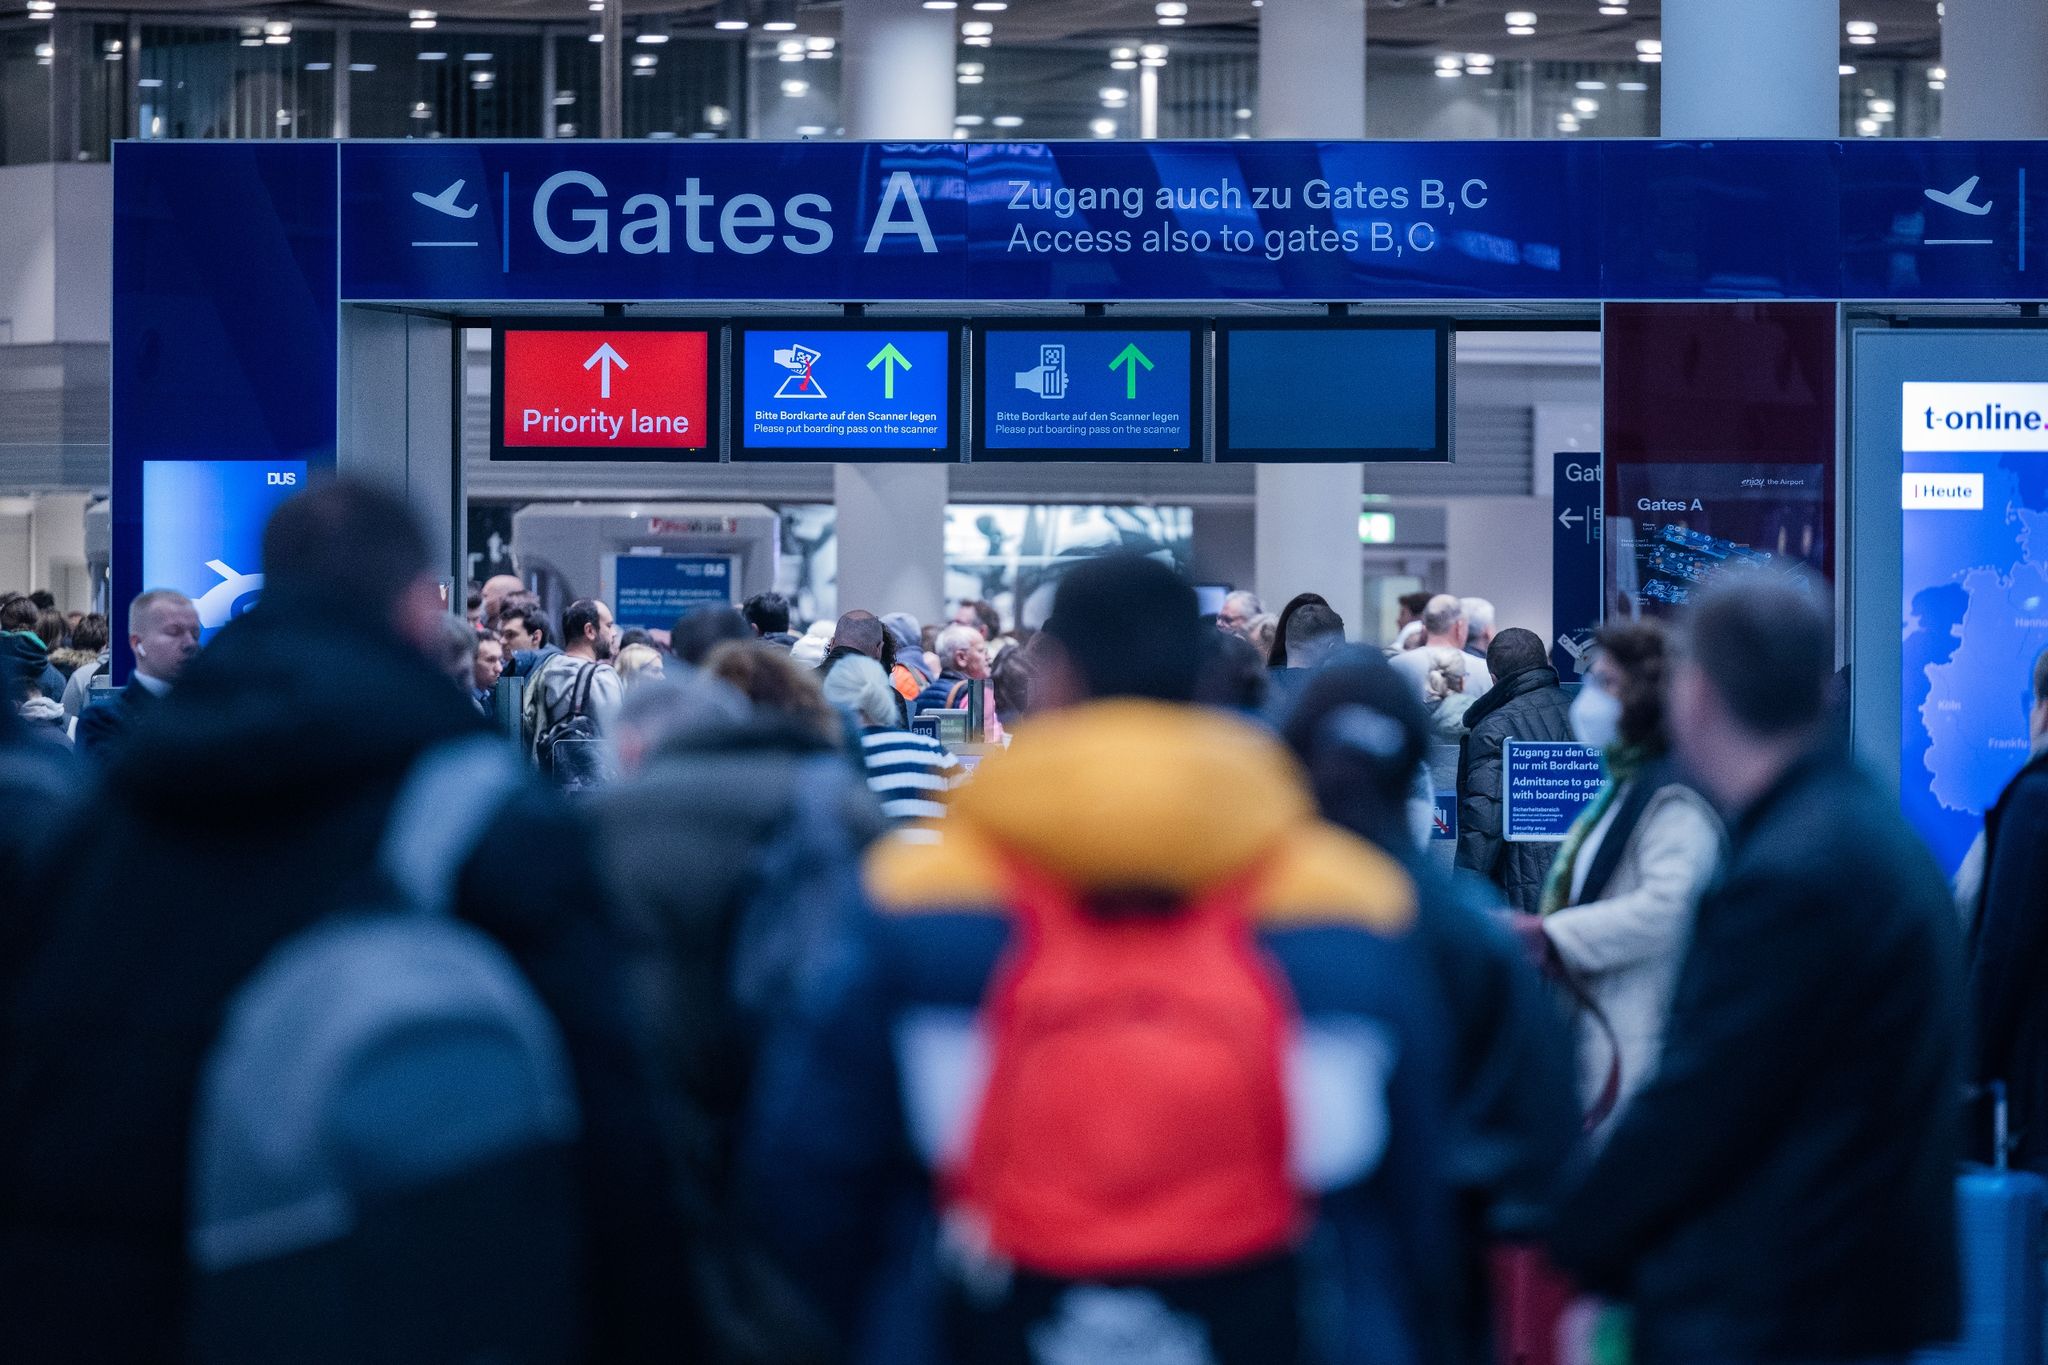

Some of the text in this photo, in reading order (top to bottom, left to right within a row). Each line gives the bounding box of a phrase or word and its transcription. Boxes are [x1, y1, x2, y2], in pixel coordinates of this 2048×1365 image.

[1007, 178, 1488, 219] Zugang auch zu Gates B,C
[532, 169, 938, 255] Gates A
[1007, 221, 1435, 261] Access also to gates B,C
[755, 410, 937, 423] Bitte Bordkarte auf den Scanner legen
[996, 411, 1180, 424] Bitte Bordkarte auf den Scanner legen
[1924, 403, 2048, 431] t-online.
[523, 408, 689, 440] Priority lane
[753, 423, 938, 435] Please put boarding pass on the scanner
[995, 424, 1026, 434] Please
[1028, 425, 1044, 436] put
[1045, 424, 1087, 436] boarding
[1088, 427, 1111, 436] pass
[1126, 425, 1142, 434] the
[1143, 427, 1181, 435] scanner
[267, 472, 296, 486] DUS
[1565, 463, 1601, 482] Gat
[1741, 477, 1765, 488] enjoy
[1923, 484, 1973, 498] Heute
[1637, 498, 1703, 512] Gates A
[1512, 747, 1550, 759] Zugang
[1551, 749, 1563, 757] zu
[1564, 747, 1584, 757] den
[1512, 761, 1600, 770] nur mit Bordkarte
[1512, 777, 1570, 787] Admittance
[1571, 777, 1582, 786] to
[1512, 790, 1534, 800] with
[1535, 790, 1580, 802] boarding
